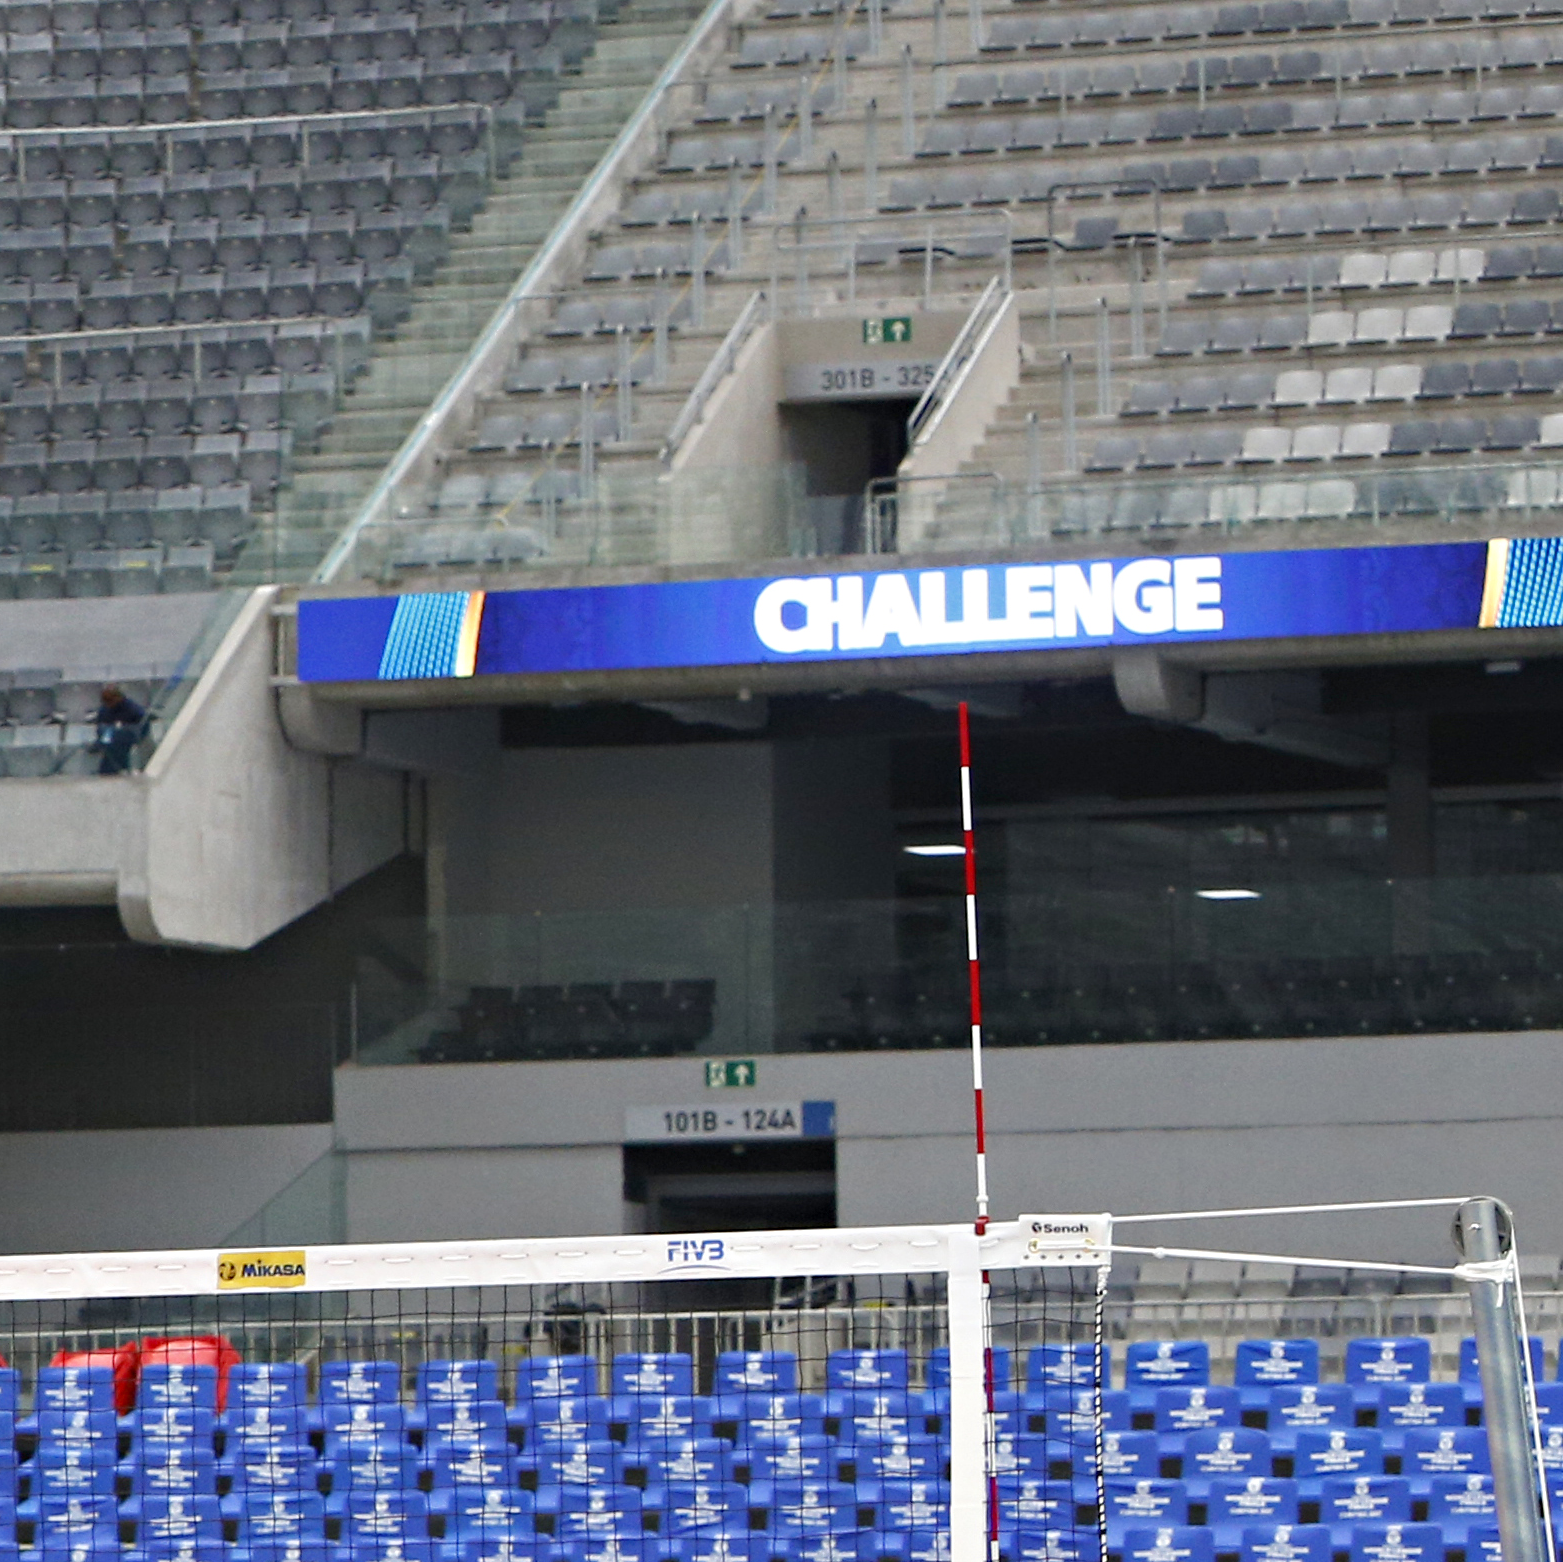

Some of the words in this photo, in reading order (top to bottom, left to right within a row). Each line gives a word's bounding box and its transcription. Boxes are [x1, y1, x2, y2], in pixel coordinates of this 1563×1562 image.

[821, 367, 874, 390] 301B
[753, 555, 1223, 655] CHALLENGE
[663, 1110, 718, 1134] 101B
[742, 1107, 797, 1131] 124A
[1044, 1223, 1089, 1234] Senoh
[667, 1239, 725, 1262] FIVB
